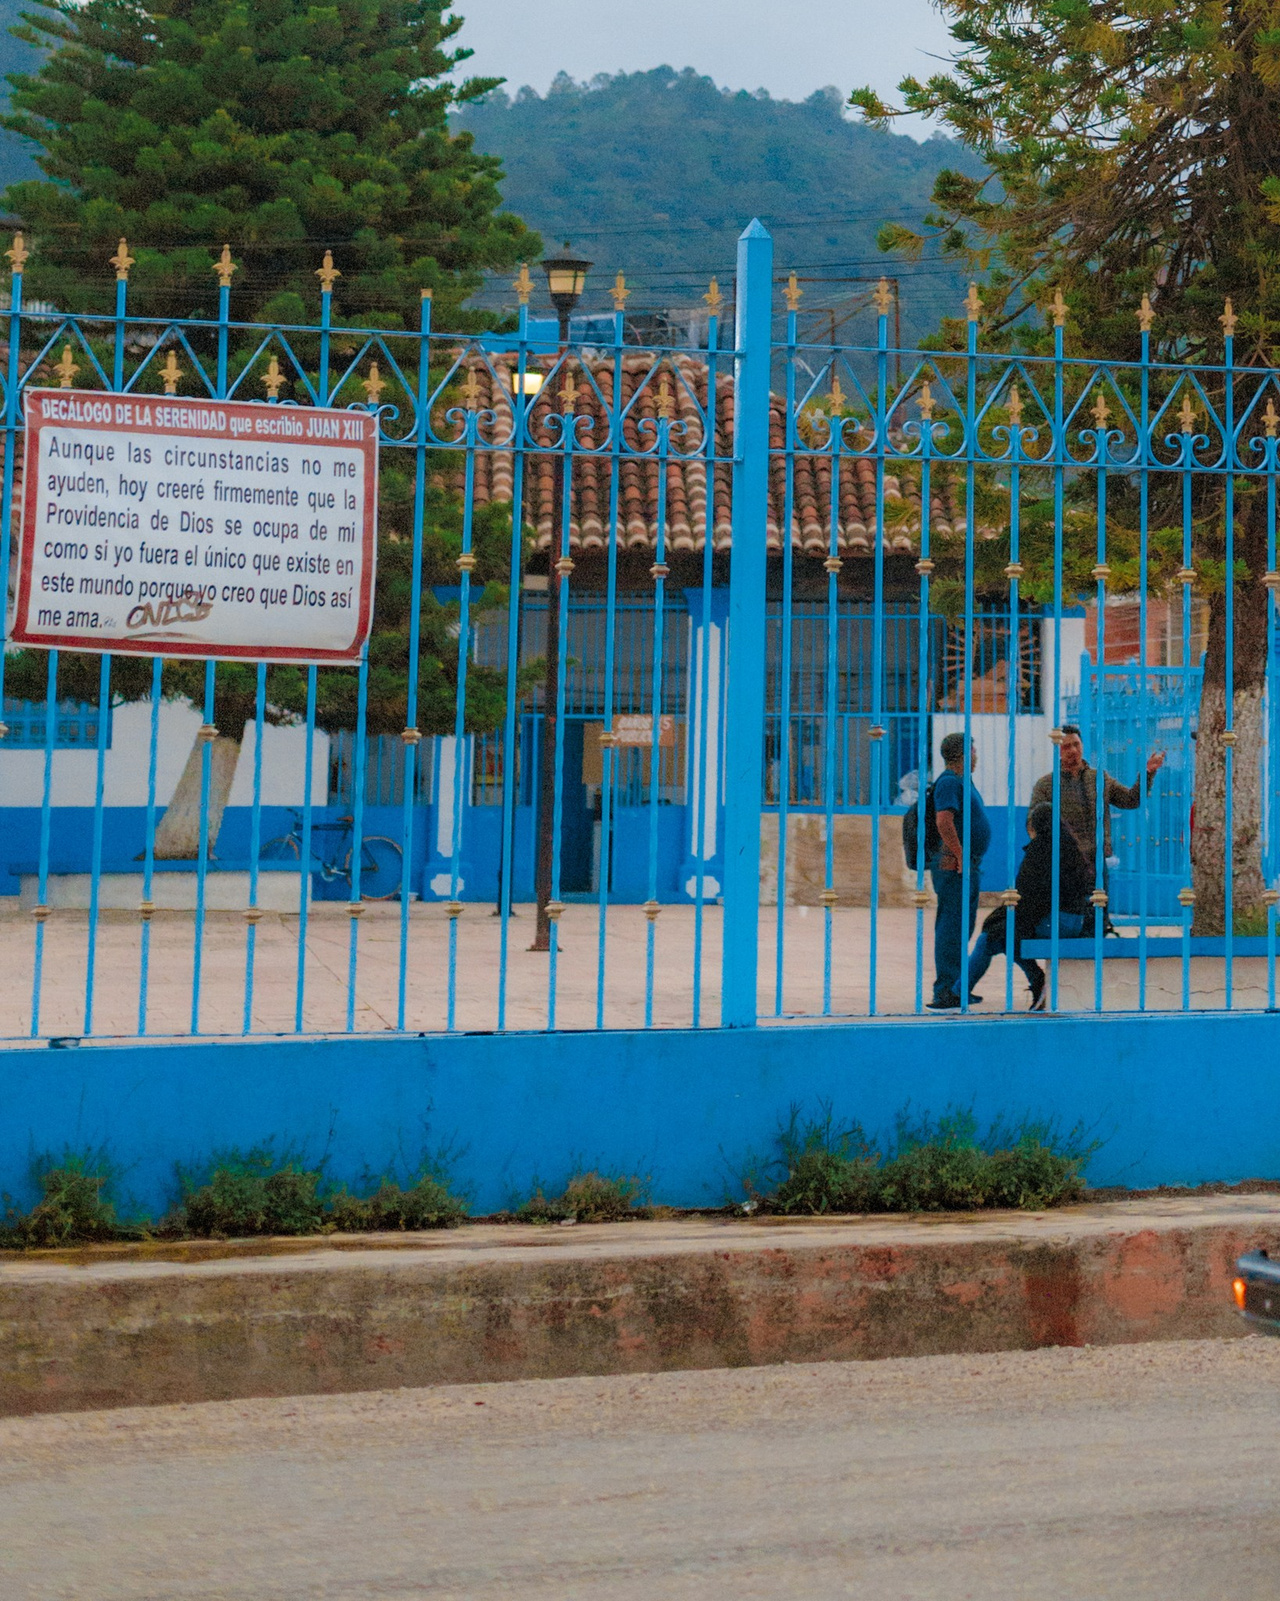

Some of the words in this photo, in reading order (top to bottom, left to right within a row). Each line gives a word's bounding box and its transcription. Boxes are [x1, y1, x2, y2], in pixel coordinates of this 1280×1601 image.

[42, 395, 111, 423] DECÁLOGO
[115, 404, 132, 424] DE
[135, 405, 152, 426] LA
[155, 407, 226, 431] SERENIDAD
[230, 417, 252, 436] que
[255, 415, 303, 436] escribio
[307, 418, 339, 439] JUAN
[343, 420, 364, 441] XIII
[48, 436, 115, 465] Aunque
[128, 442, 151, 464] las
[164, 450, 289, 473] circunstancias
[302, 458, 321, 475] no
[334, 461, 356, 478] me
[48, 471, 109, 497] ayuden,
[119, 474, 147, 502] hoy
[157, 479, 204, 500] creeré
[214, 480, 298, 506] firmemente
[308, 491, 334, 512] que
[344, 489, 356, 510] la
[46, 503, 139, 529] Providencia
[151, 509, 168, 531] de
[180, 511, 213, 534] Dios
[225, 519, 242, 535] se
[254, 521, 298, 543] ocupa
[310, 520, 327, 541] de
[338, 522, 355, 542] mi
[44, 541, 88, 559] como
[95, 539, 108, 561] si
[114, 545, 133, 567] yo
[140, 542, 178, 564] fuera
[185, 545, 198, 566] el
[205, 545, 246, 569] único
[253, 553, 280, 576] que
[287, 551, 330, 574] existe
[337, 559, 354, 575] en
[42, 572, 74, 593] este
[80, 574, 133, 595] mundo
[138, 581, 194, 604] porque
[198, 584, 216, 606] yo
[222, 585, 255, 603] creo
[260, 587, 287, 609] que
[293, 584, 326, 607] Dios
[331, 587, 353, 608] así
[38, 609, 61, 626] me
[66, 611, 102, 628] ama.
